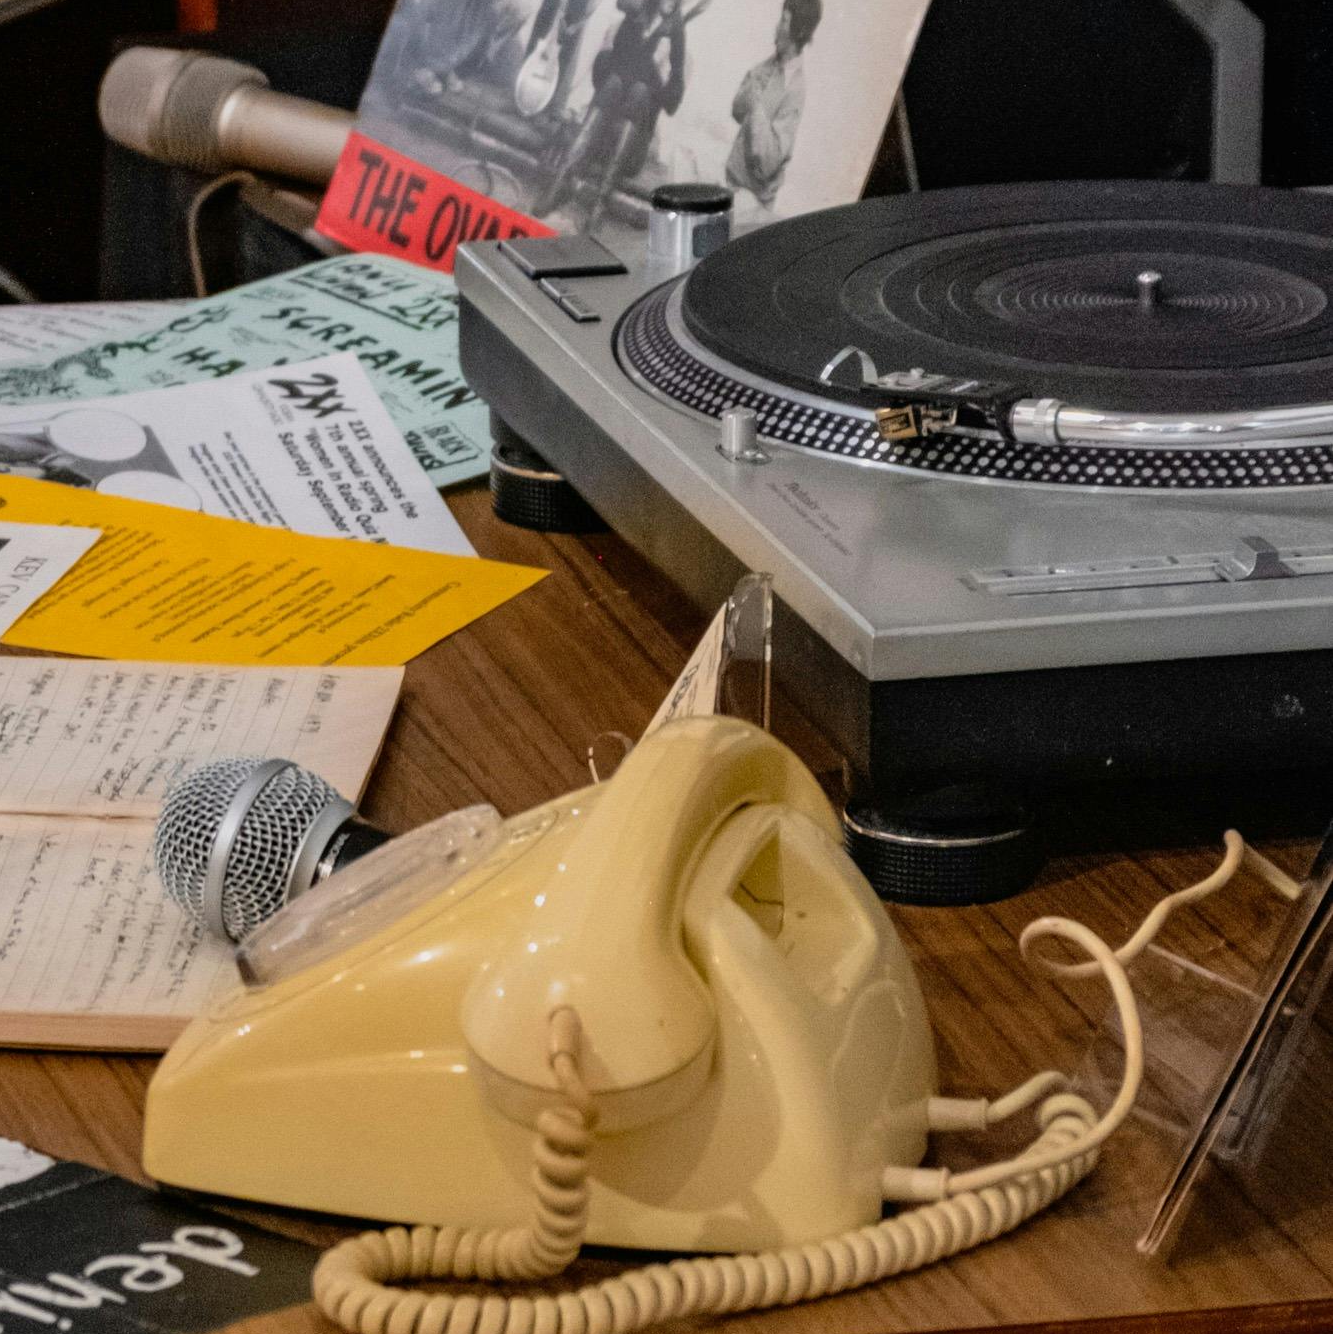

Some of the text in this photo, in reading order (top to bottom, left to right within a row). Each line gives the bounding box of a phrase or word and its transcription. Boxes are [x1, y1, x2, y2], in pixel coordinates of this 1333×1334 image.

[349, 148, 427, 248] THE
[266, 372, 360, 419] 2XX
[277, 431, 352, 535] Saturday September
[324, 422, 389, 514] 7th annual spring
[335, 480, 362, 513] Radio
[354, 512, 379, 536] Quiz
[347, 419, 419, 520] 2XX announces the
[10, 555, 49, 583] KEV
